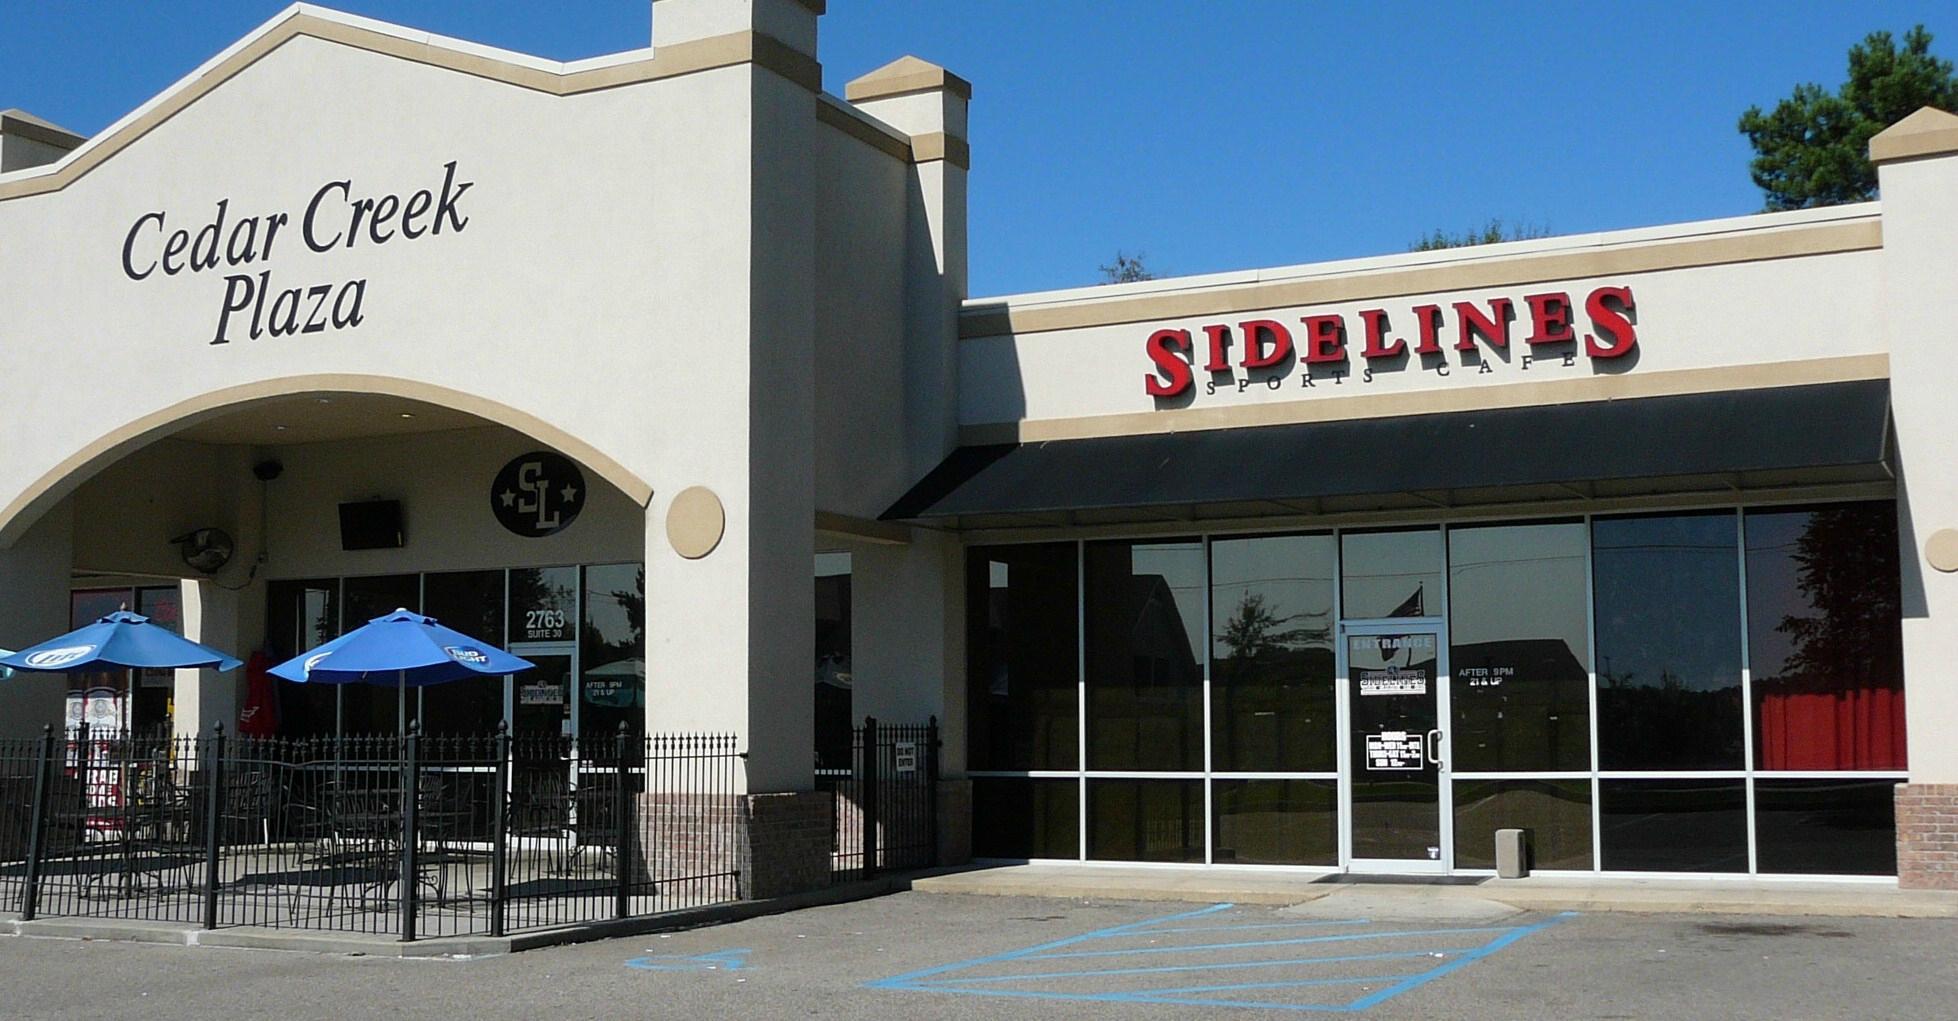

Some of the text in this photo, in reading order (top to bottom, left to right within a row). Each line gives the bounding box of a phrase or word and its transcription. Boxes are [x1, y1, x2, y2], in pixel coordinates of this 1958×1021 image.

[122, 160, 474, 281] Cedar Creek
[209, 270, 367, 346] Plaza
[1145, 286, 1637, 397] SIDELINES
[1206, 352, 1575, 395] SPORTS CAFE
[518, 462, 560, 529] SL
[526, 610, 565, 629] 2763
[527, 629, 563, 639] SUITE 30
[1353, 638, 1432, 650] ENTRANCE
[1459, 667, 1488, 677] AFTER
[1469, 677, 1479, 686] 21
[1490, 676, 1503, 686] UP
[585, 681, 606, 689] AFTER
